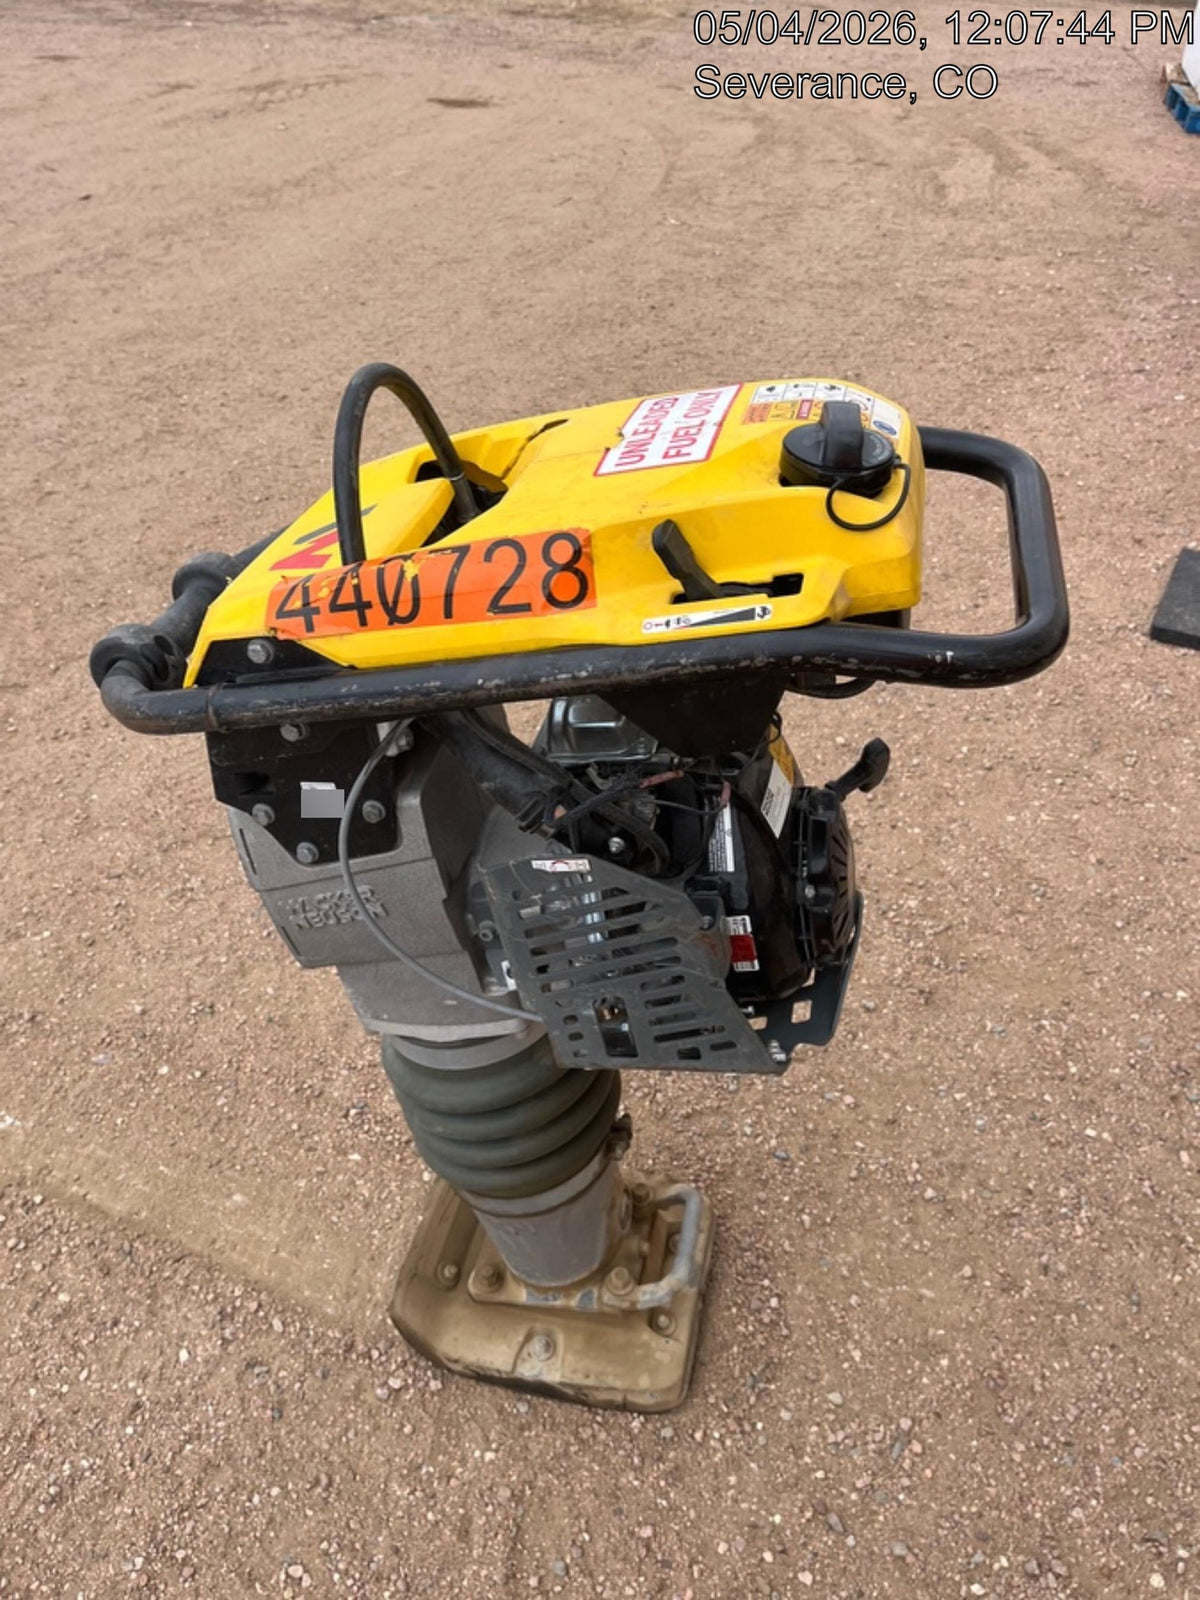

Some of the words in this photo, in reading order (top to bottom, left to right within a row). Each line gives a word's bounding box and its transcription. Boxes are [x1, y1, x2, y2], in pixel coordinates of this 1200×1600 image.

[683, 390, 722, 419] ONLY
[614, 398, 678, 467] UNLEADED
[661, 419, 706, 459] FUEL
[275, 532, 589, 633] 440728
